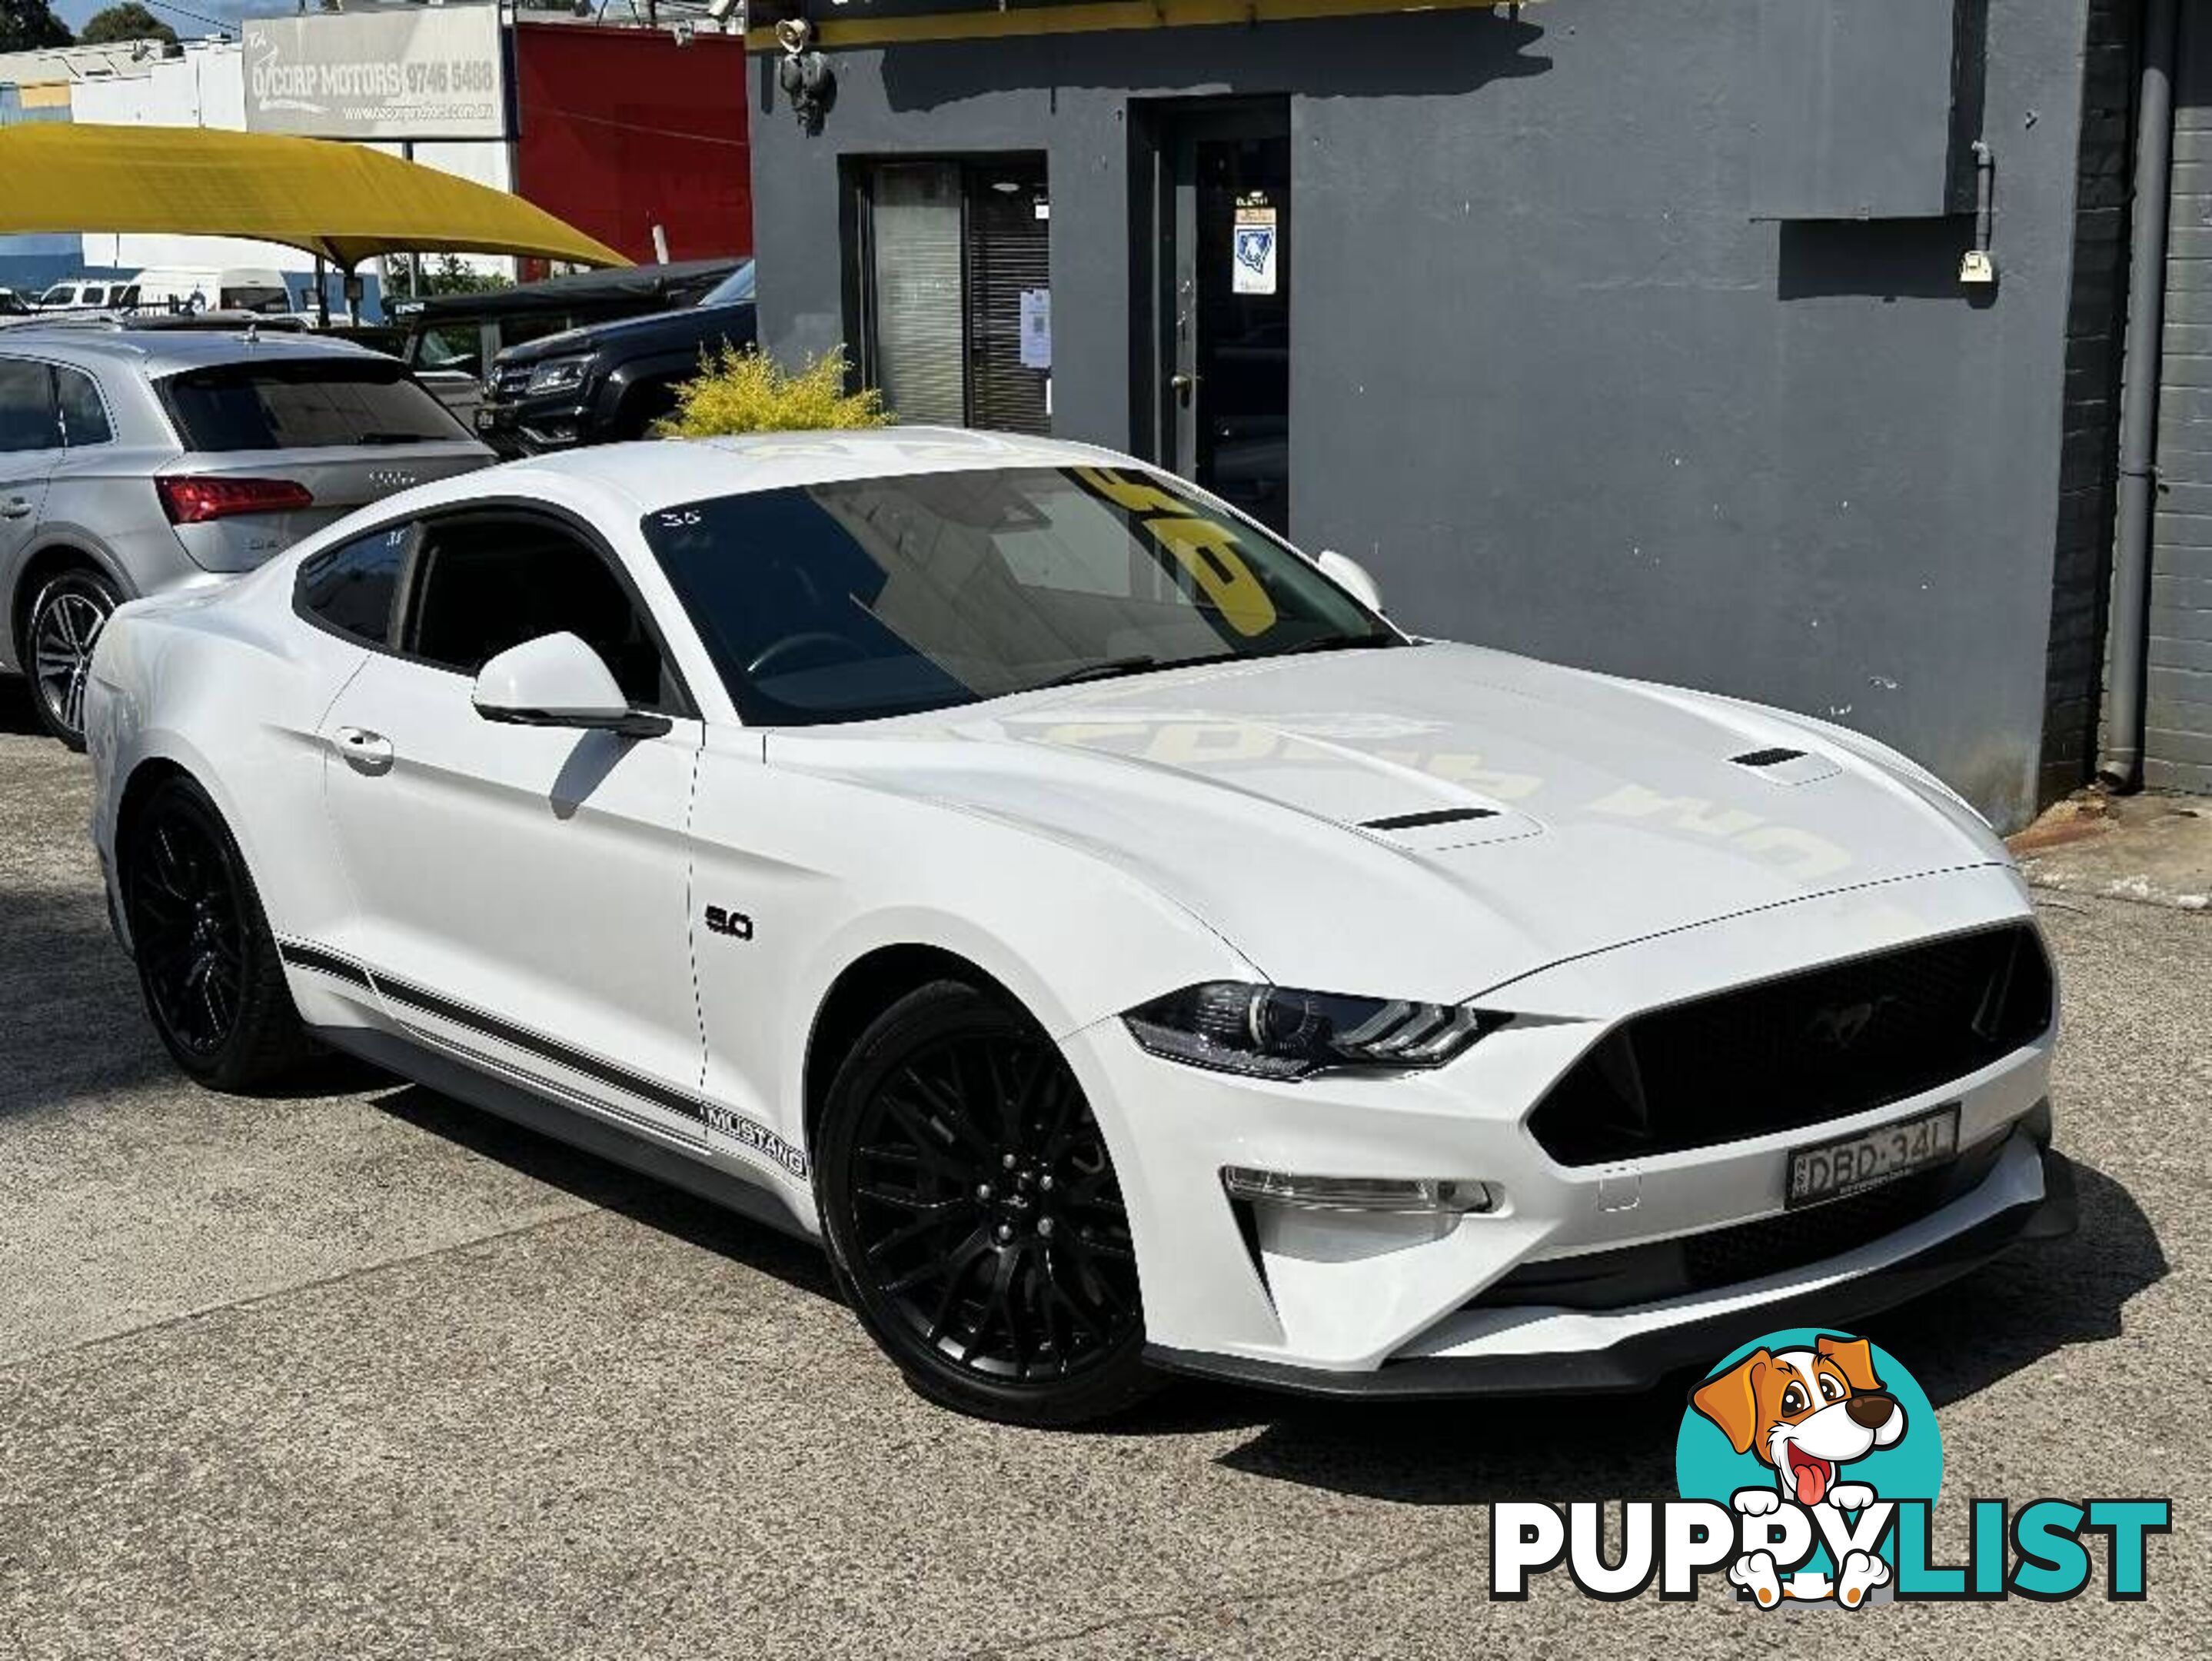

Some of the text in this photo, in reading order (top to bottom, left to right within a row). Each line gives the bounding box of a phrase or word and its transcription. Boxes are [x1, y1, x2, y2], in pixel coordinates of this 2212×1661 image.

[320, 62, 401, 97] MOTORS
[407, 62, 448, 93] 9746
[707, 1107, 808, 1177] MUSTANG
